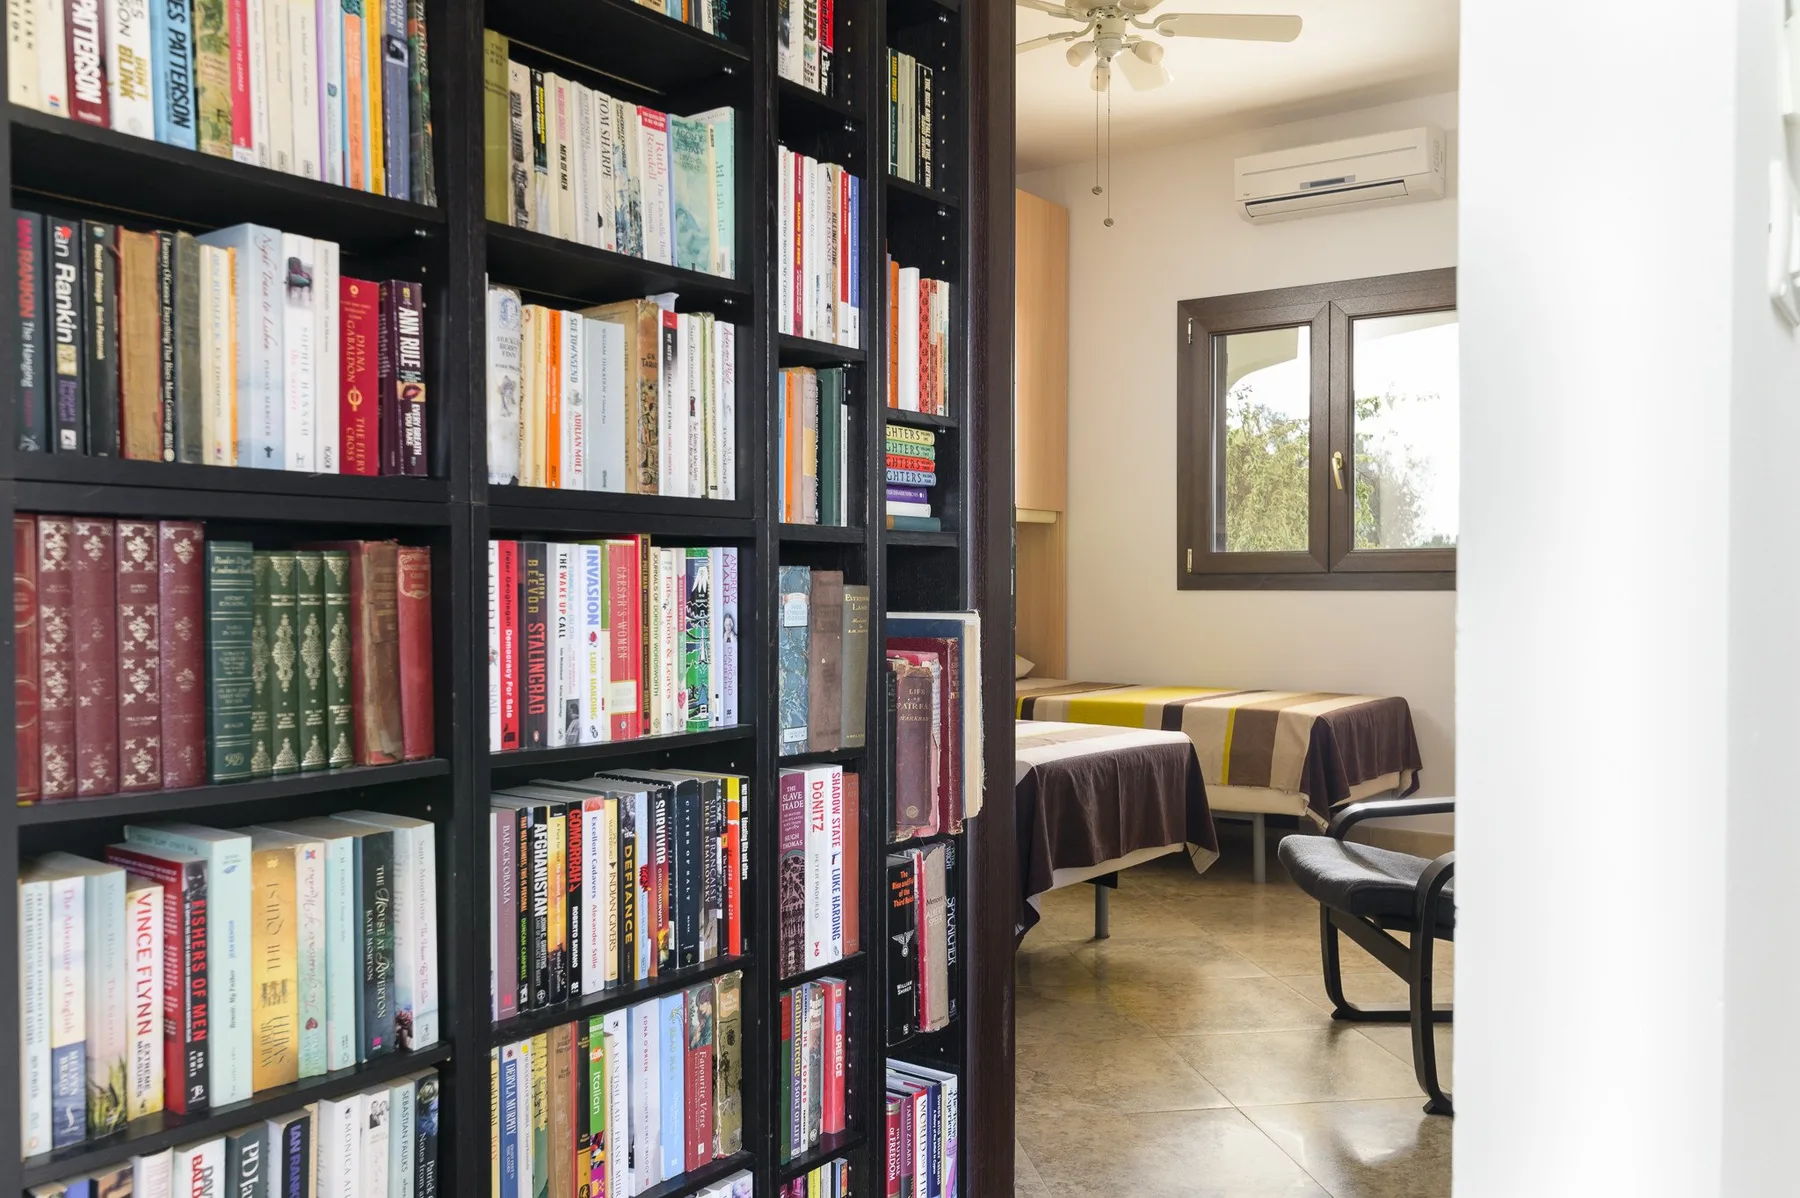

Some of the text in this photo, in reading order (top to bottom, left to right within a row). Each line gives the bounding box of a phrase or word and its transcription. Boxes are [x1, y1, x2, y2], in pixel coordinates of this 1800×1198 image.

[72, 0, 102, 104] PATTERSON
[117, 44, 136, 101] BLINK
[237, 63, 245, 92] LEOPARD
[417, 28, 428, 78] PARKS
[168, 27, 191, 129] PATTERSON
[560, 143, 568, 163] MEN
[599, 97, 612, 180] TOM SHARPE
[646, 132, 657, 180] Rendell
[656, 142, 667, 174] Ruth
[161, 237, 173, 270] Flannery
[18, 218, 37, 389] IAN RANKIN The Hanging
[56, 262, 77, 343] Rankin
[346, 320, 356, 382] GABALDON
[356, 335, 366, 372] DIANA
[398, 306, 421, 367] ANN RULE
[570, 318, 579, 384] SUE TOWNSEND
[667, 333, 672, 345] WE
[346, 427, 356, 461] CROSS
[356, 417, 366, 436] THE
[405, 412, 414, 446] YOU TAKE
[411, 403, 422, 456] EVERY BREATH
[574, 411, 583, 475] ADRIAN MOLE
[504, 576, 512, 627] Geoghegan
[528, 559, 539, 613] BEEVOR
[586, 549, 599, 625] INVASION
[653, 593, 659, 602] OF
[722, 554, 730, 606] MARR
[559, 602, 567, 615] UP
[559, 616, 567, 639] CALL
[616, 566, 629, 659] CAESAR'S WOMEN
[665, 609, 673, 645] Shoots
[505, 629, 514, 678] Democracy
[529, 622, 545, 715] STALINGRAD
[589, 652, 597, 676] LUKE
[782, 792, 803, 802] SLAVE
[782, 801, 804, 811] TRADE
[812, 781, 824, 832] DÖNITZ
[570, 809, 582, 883] GOMORRAH
[656, 800, 666, 865] SURVIVOR
[832, 772, 841, 940] SHADOW STATE LUKE HARDING
[377, 866, 385, 886] THE
[502, 825, 512, 904] BARACK OBAMA
[533, 823, 548, 917] AFGHANISTAN
[266, 883, 284, 935] QUEST
[625, 845, 633, 944] DEFIANCE
[947, 897, 956, 966] SPYCATCHER
[136, 893, 154, 1035] VINCE FLYNN
[191, 900, 207, 1042] FISHERS OF MEN
[366, 938, 374, 980] MORTON
[794, 990, 803, 1037] Graham
[143, 1042, 152, 1090] EXTREME
[260, 1020, 273, 1068] WILBUR
[273, 1016, 290, 1065] SMITH
[794, 1036, 803, 1076] Greene
[136, 1040, 145, 1098] MEASURES
[593, 1071, 602, 1114] Italian
[699, 1051, 708, 1128] Favourite Verse
[506, 1063, 516, 1135] DERVLA MURPHY
[290, 1125, 302, 1154] IAN
[401, 1091, 410, 1172] SEBASTIAN FAULKS
[426, 1160, 436, 1194] Patrick
